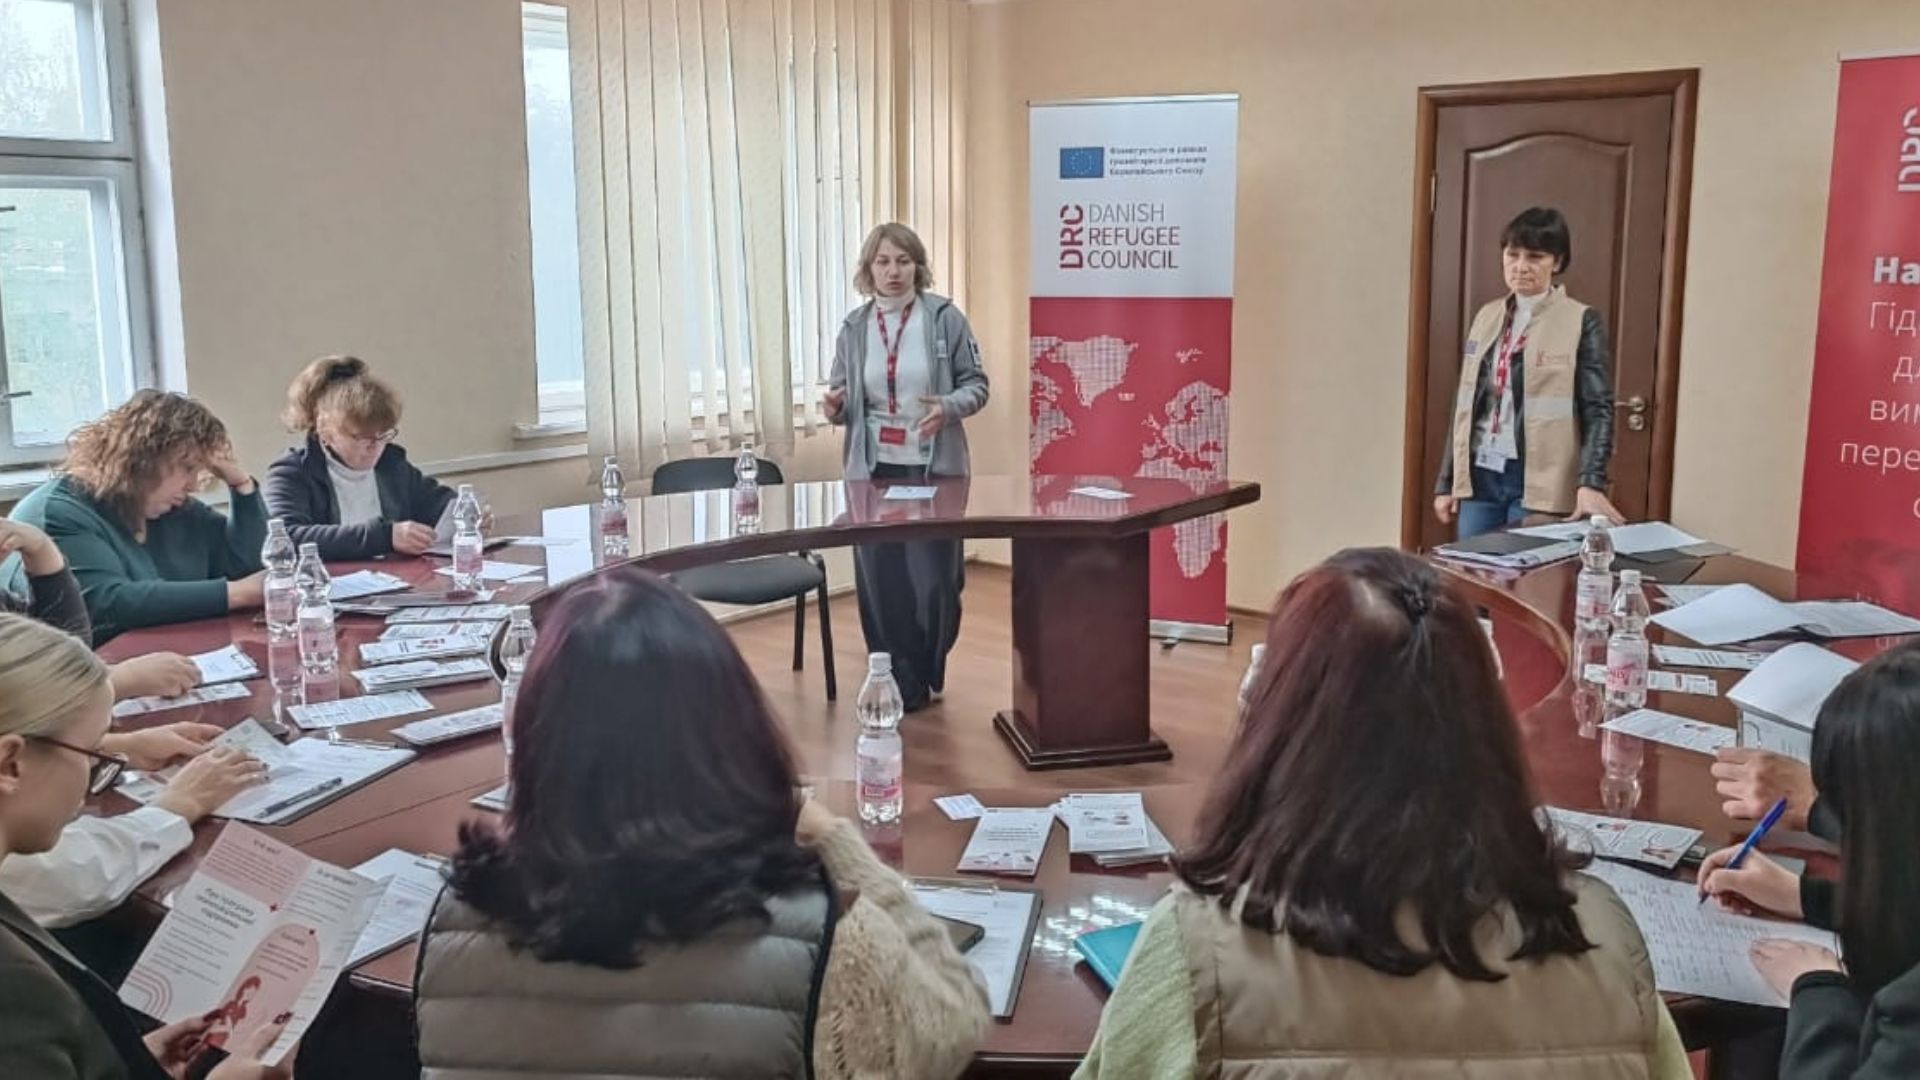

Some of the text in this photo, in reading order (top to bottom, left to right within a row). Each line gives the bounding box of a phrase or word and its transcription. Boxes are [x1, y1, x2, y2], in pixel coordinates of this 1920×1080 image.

[1088, 203, 1164, 224] DANISH
[1060, 204, 1084, 269] DRC
[1088, 226, 1180, 246] REFUGEE
[1087, 250, 1179, 268] COUNCIL
